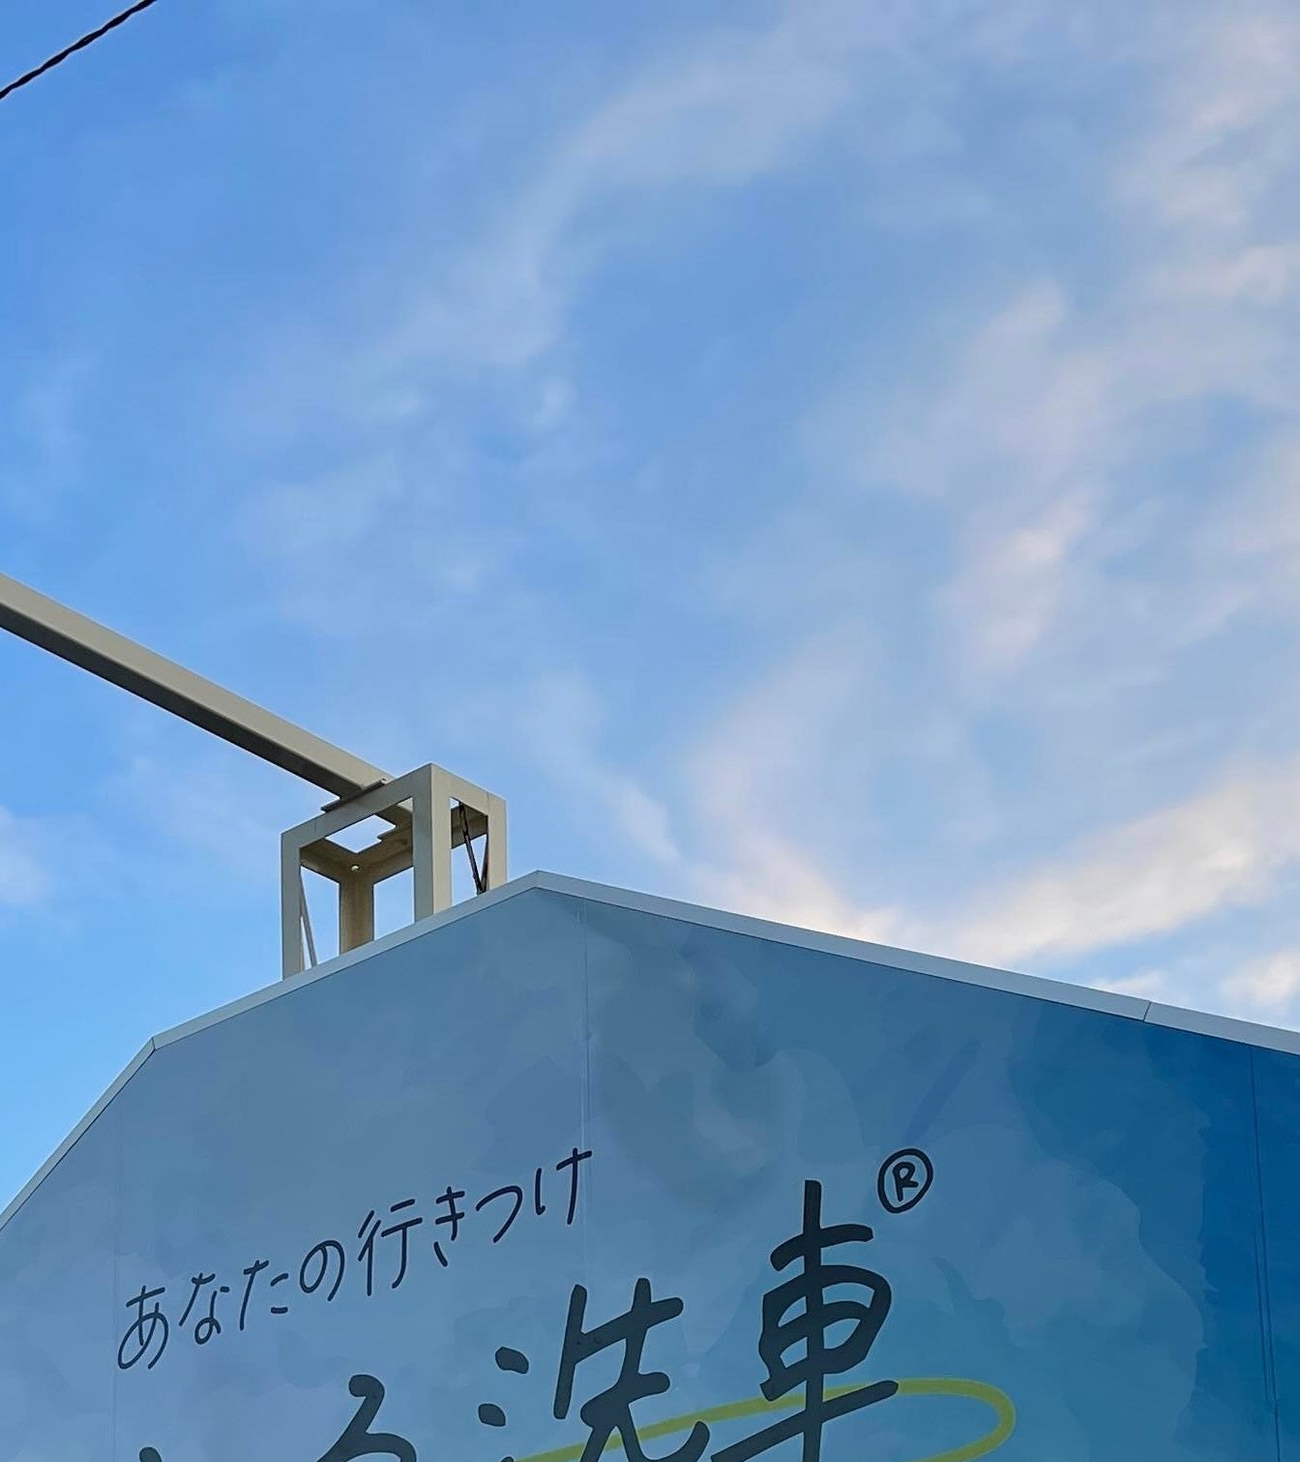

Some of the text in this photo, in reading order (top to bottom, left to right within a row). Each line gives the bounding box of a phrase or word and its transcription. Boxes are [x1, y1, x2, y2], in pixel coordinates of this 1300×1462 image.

[118, 1148, 592, 1370] あなたの行きつけ
